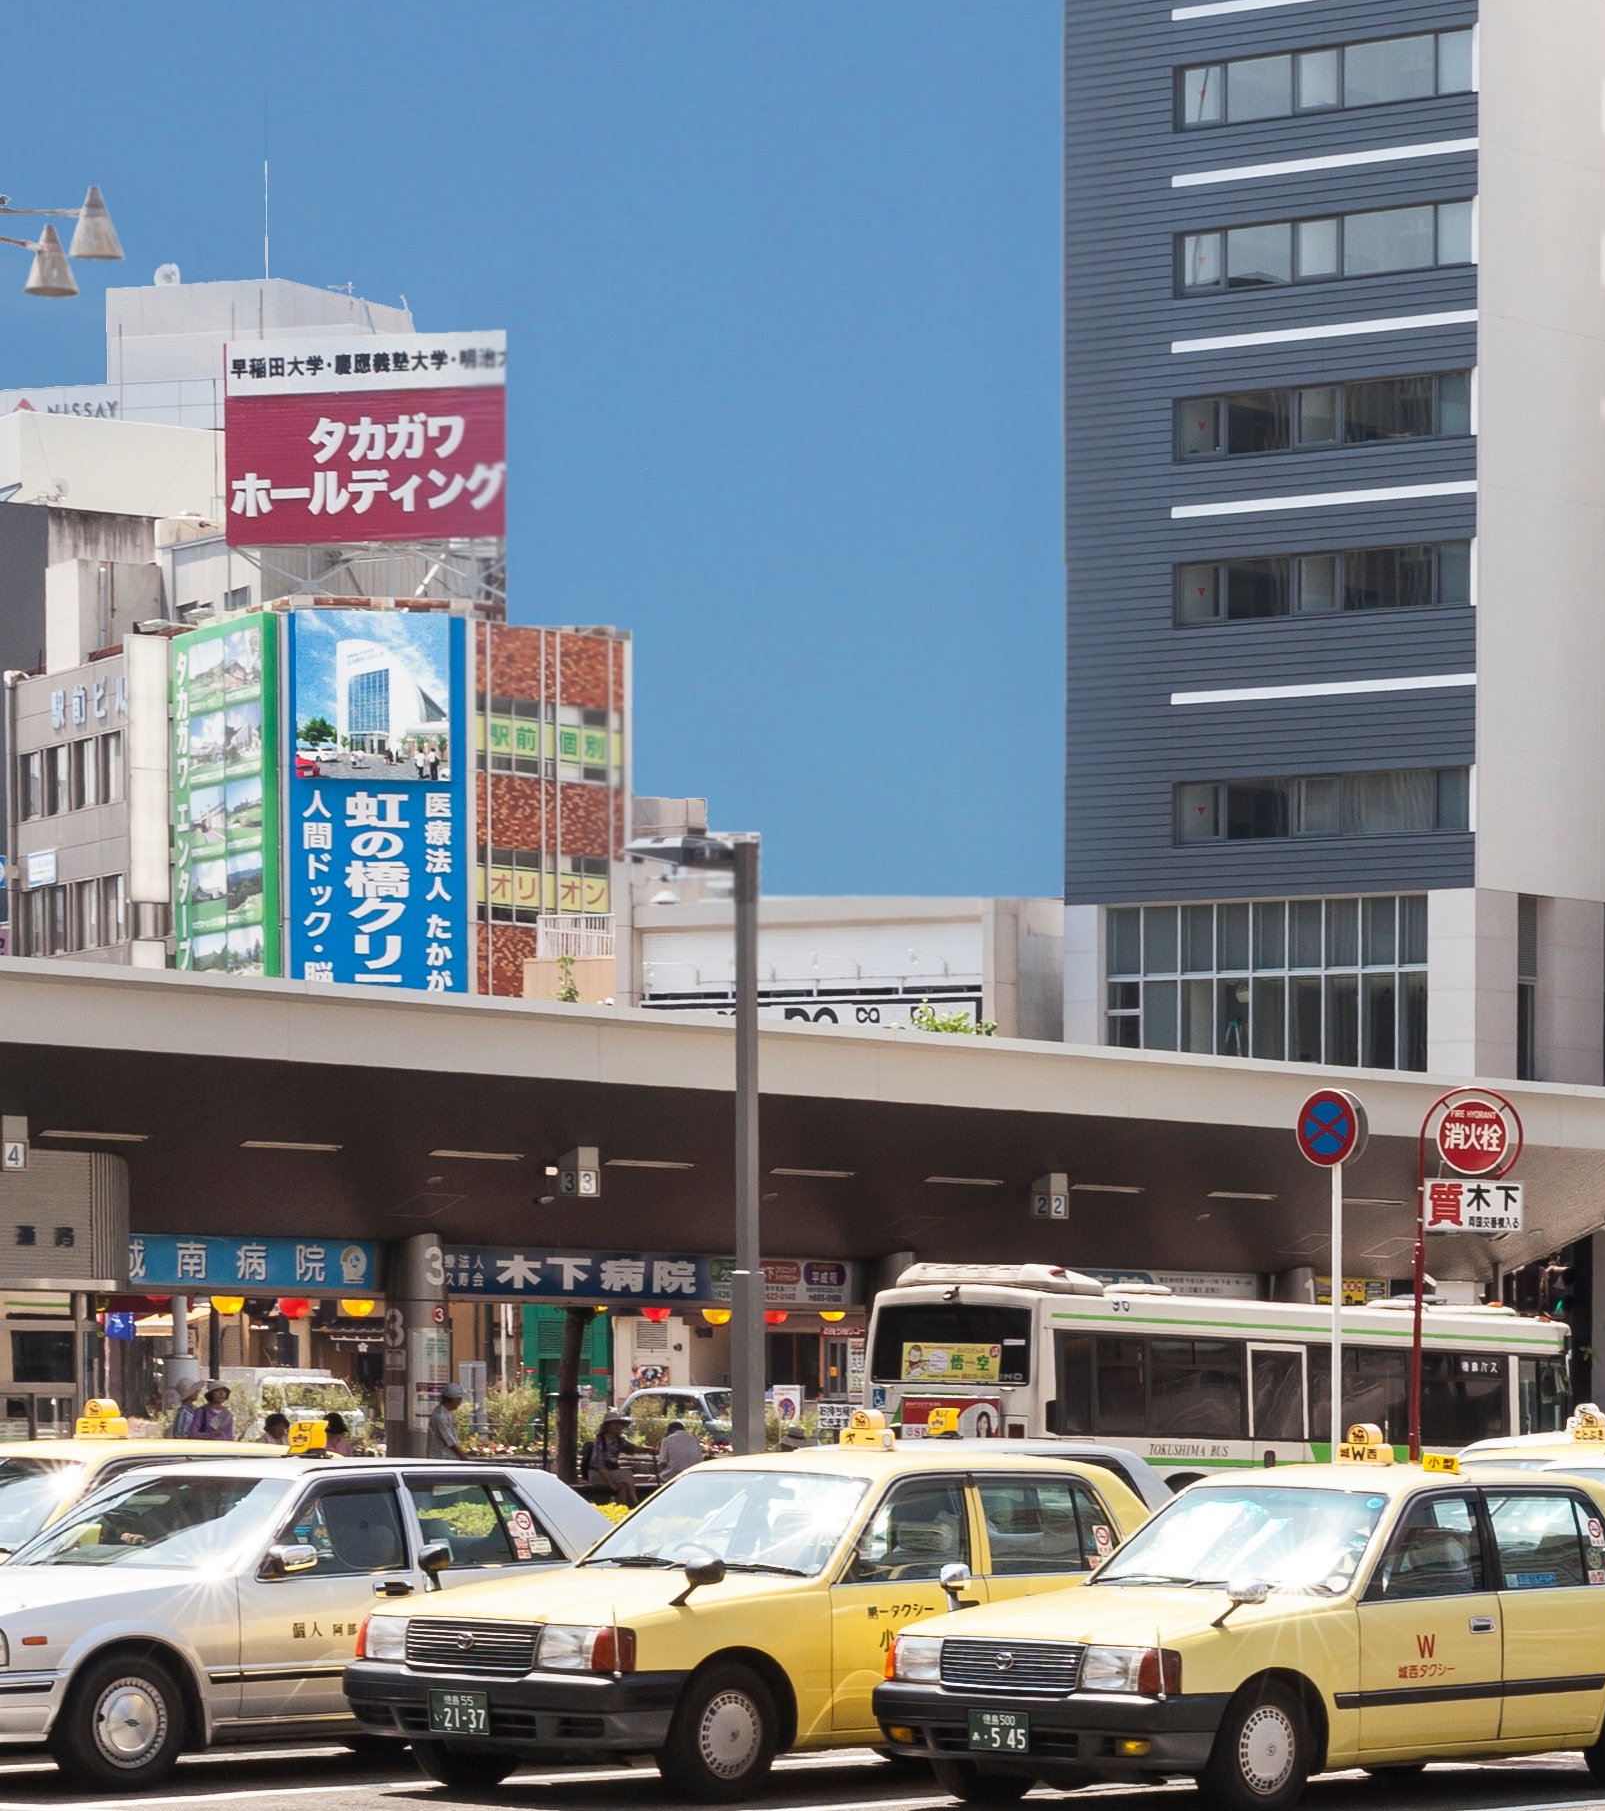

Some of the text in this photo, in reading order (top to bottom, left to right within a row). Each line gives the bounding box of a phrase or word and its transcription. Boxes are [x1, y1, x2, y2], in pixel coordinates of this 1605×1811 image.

[47, 401, 118, 418] NISSAY
[308, 412, 465, 464] タカガワ
[231, 462, 506, 517] ホールディング
[177, 651, 189, 789] タカガワ
[425, 793, 452, 902] 医療法人
[491, 874, 605, 905] オリオン
[1451, 1109, 1496, 1120] FIRE HYDRANT
[1444, 1123, 1502, 1152] 消火栓
[8, 1147, 20, 1165] 4
[582, 1173, 593, 1191] 3
[1037, 1198, 1048, 1214] 2
[1053, 1198, 1063, 1214] 2
[1428, 1183, 1520, 1227] 質 木下
[425, 1246, 444, 1286] 3
[496, 1255, 697, 1295] 木下病院
[434, 1307, 445, 1322] 3
[1148, 1443, 1229, 1457] TOKUSHIMA BUS
[1416, 1633, 1436, 1659] W
